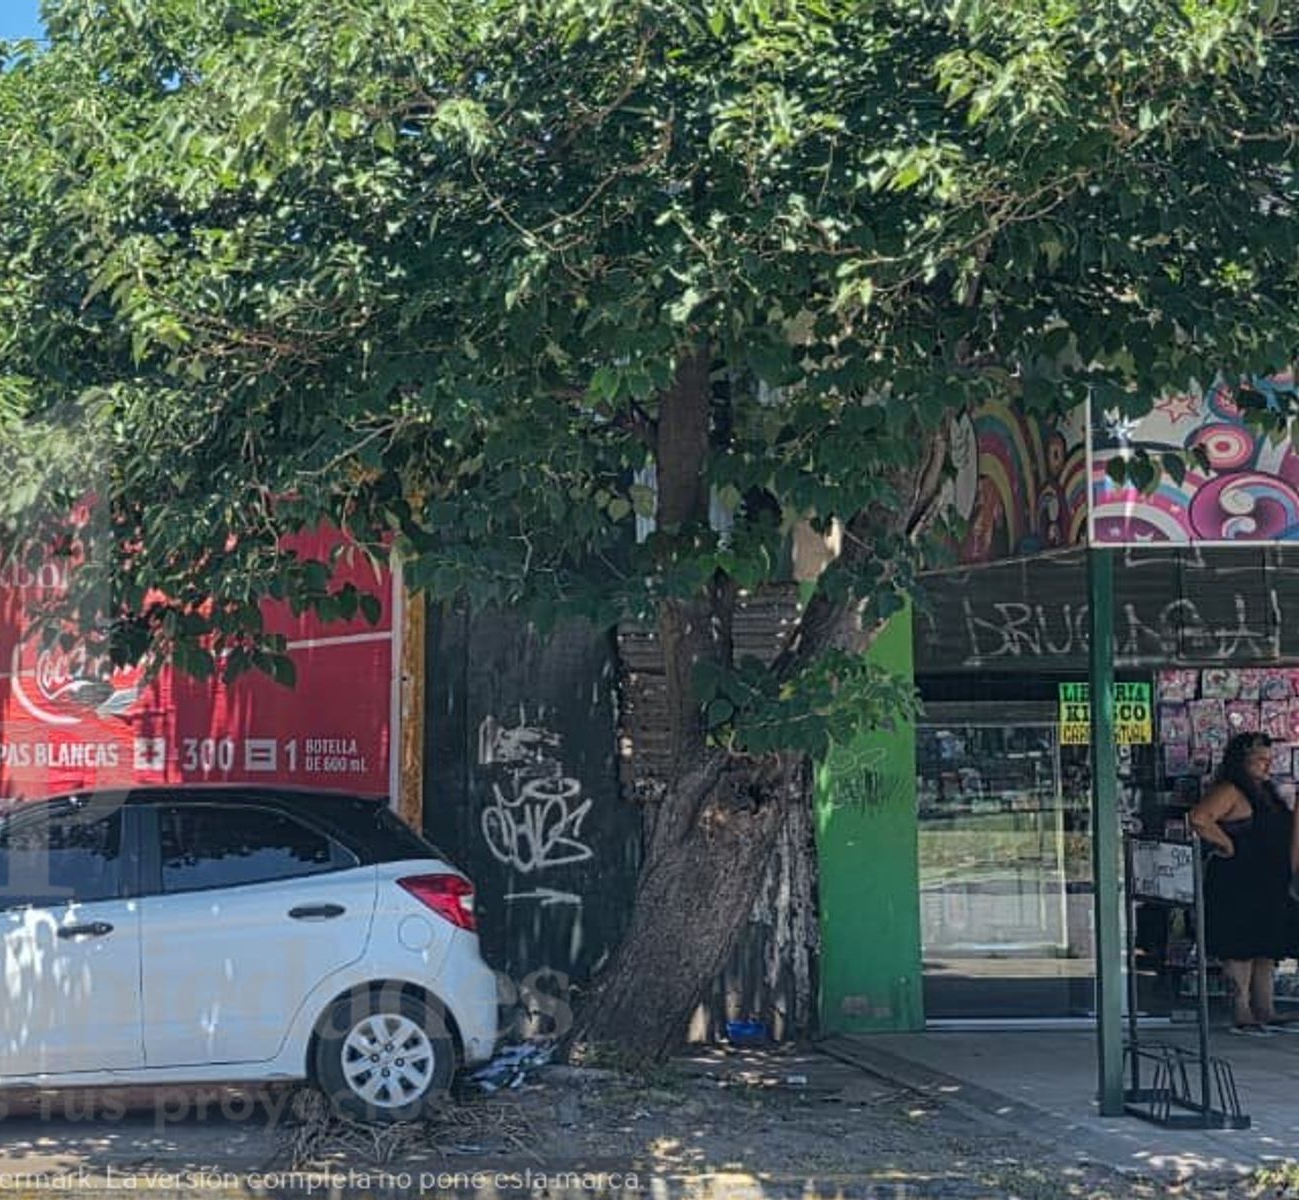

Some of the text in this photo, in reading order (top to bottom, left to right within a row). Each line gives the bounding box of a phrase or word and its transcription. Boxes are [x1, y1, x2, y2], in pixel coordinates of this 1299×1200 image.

[1066, 704, 1147, 721] KICO
[305, 739, 358, 754] BOTELLA
[34, 742, 119, 768] BLANCAS
[182, 739, 235, 772] 300
[284, 740, 298, 772] 1
[305, 756, 323, 772] DE
[324, 756, 347, 772] 600
